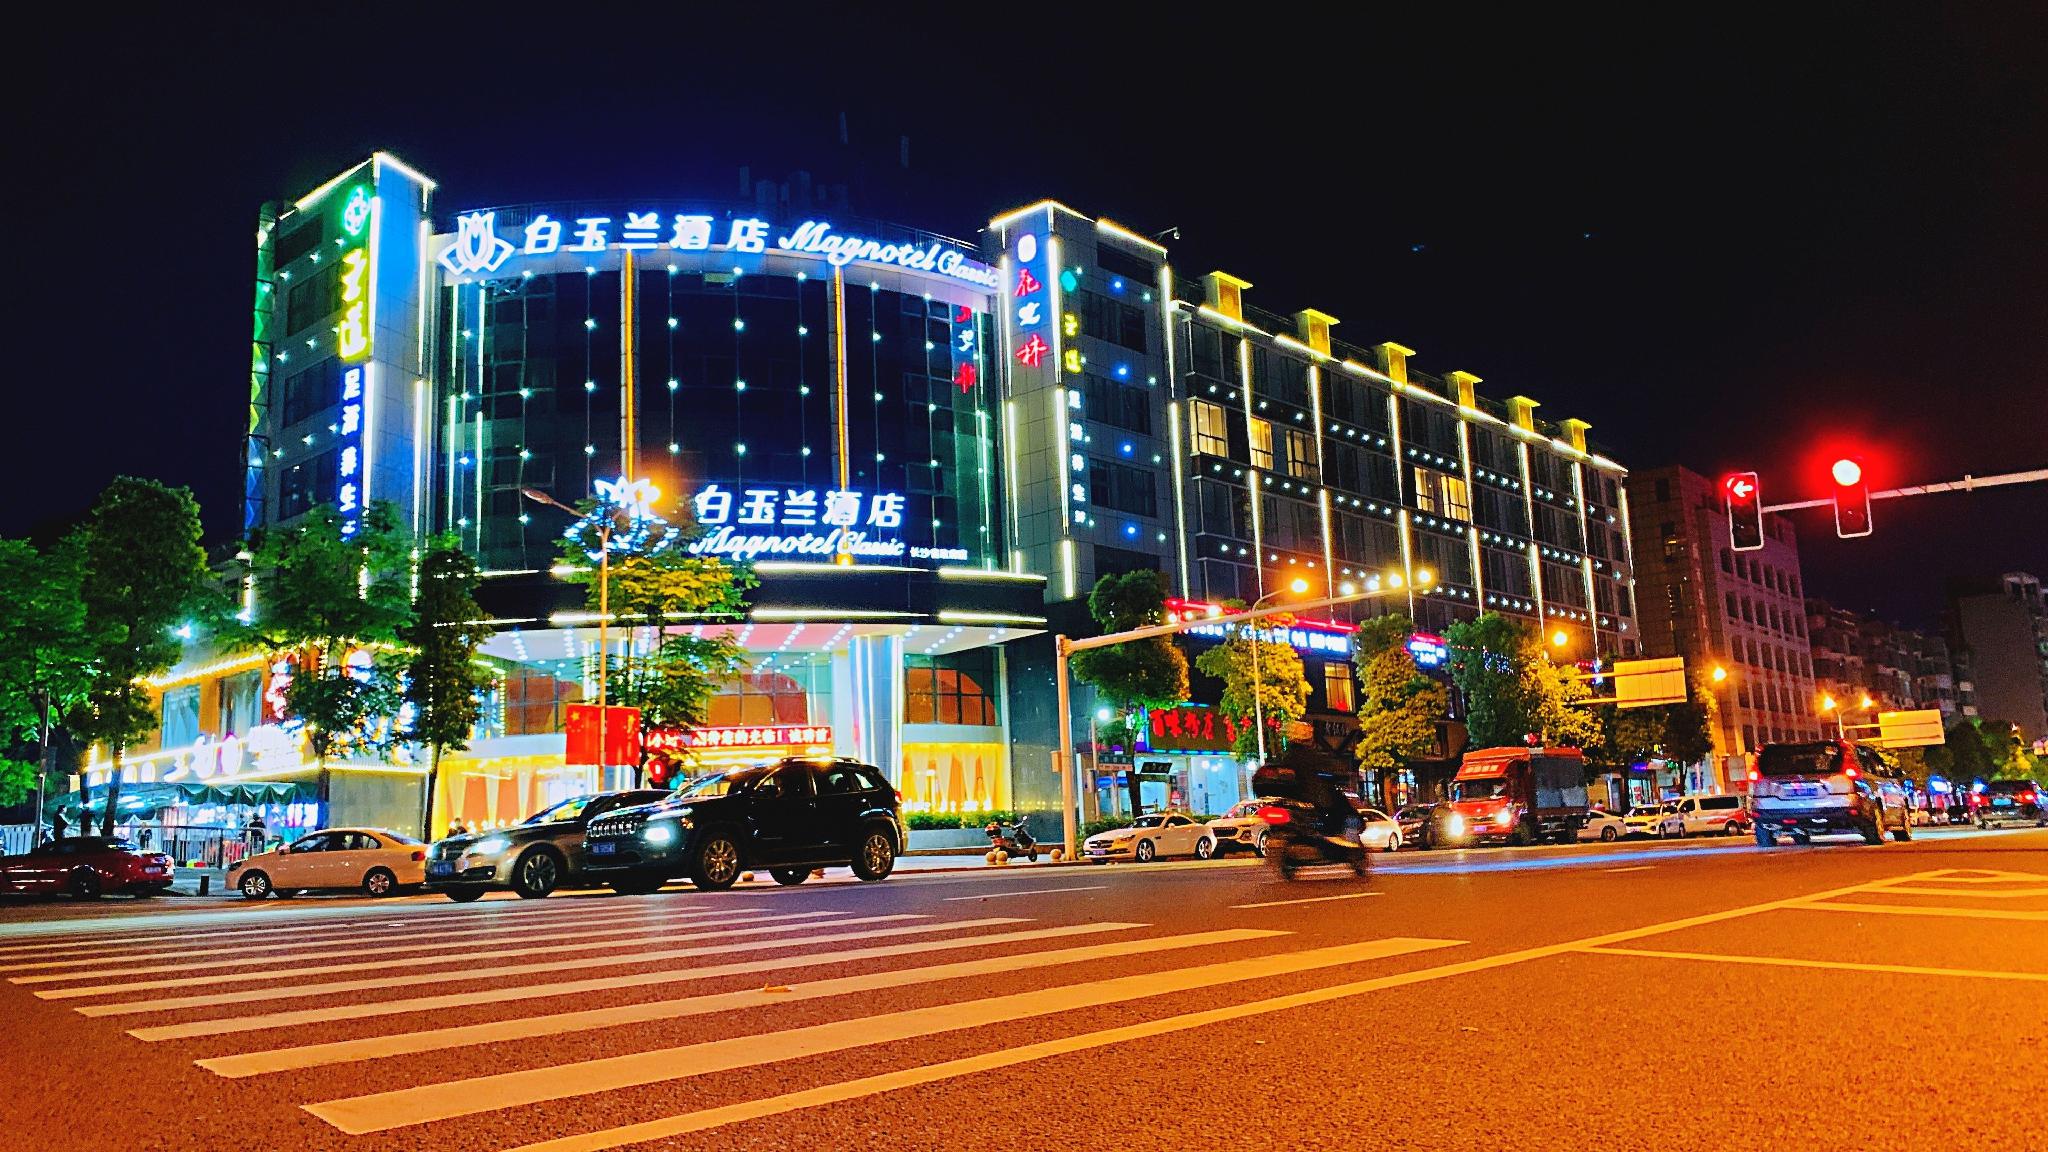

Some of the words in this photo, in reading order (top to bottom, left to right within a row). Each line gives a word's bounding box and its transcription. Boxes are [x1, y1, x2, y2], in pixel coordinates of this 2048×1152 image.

[524, 213, 770, 255] 白玉兰酒店
[779, 220, 940, 266] Magnotel
[937, 249, 1001, 289] Classic
[696, 486, 906, 528] 白玉兰酒店
[690, 529, 843, 564] Magnotel
[838, 529, 905, 558] Classic
